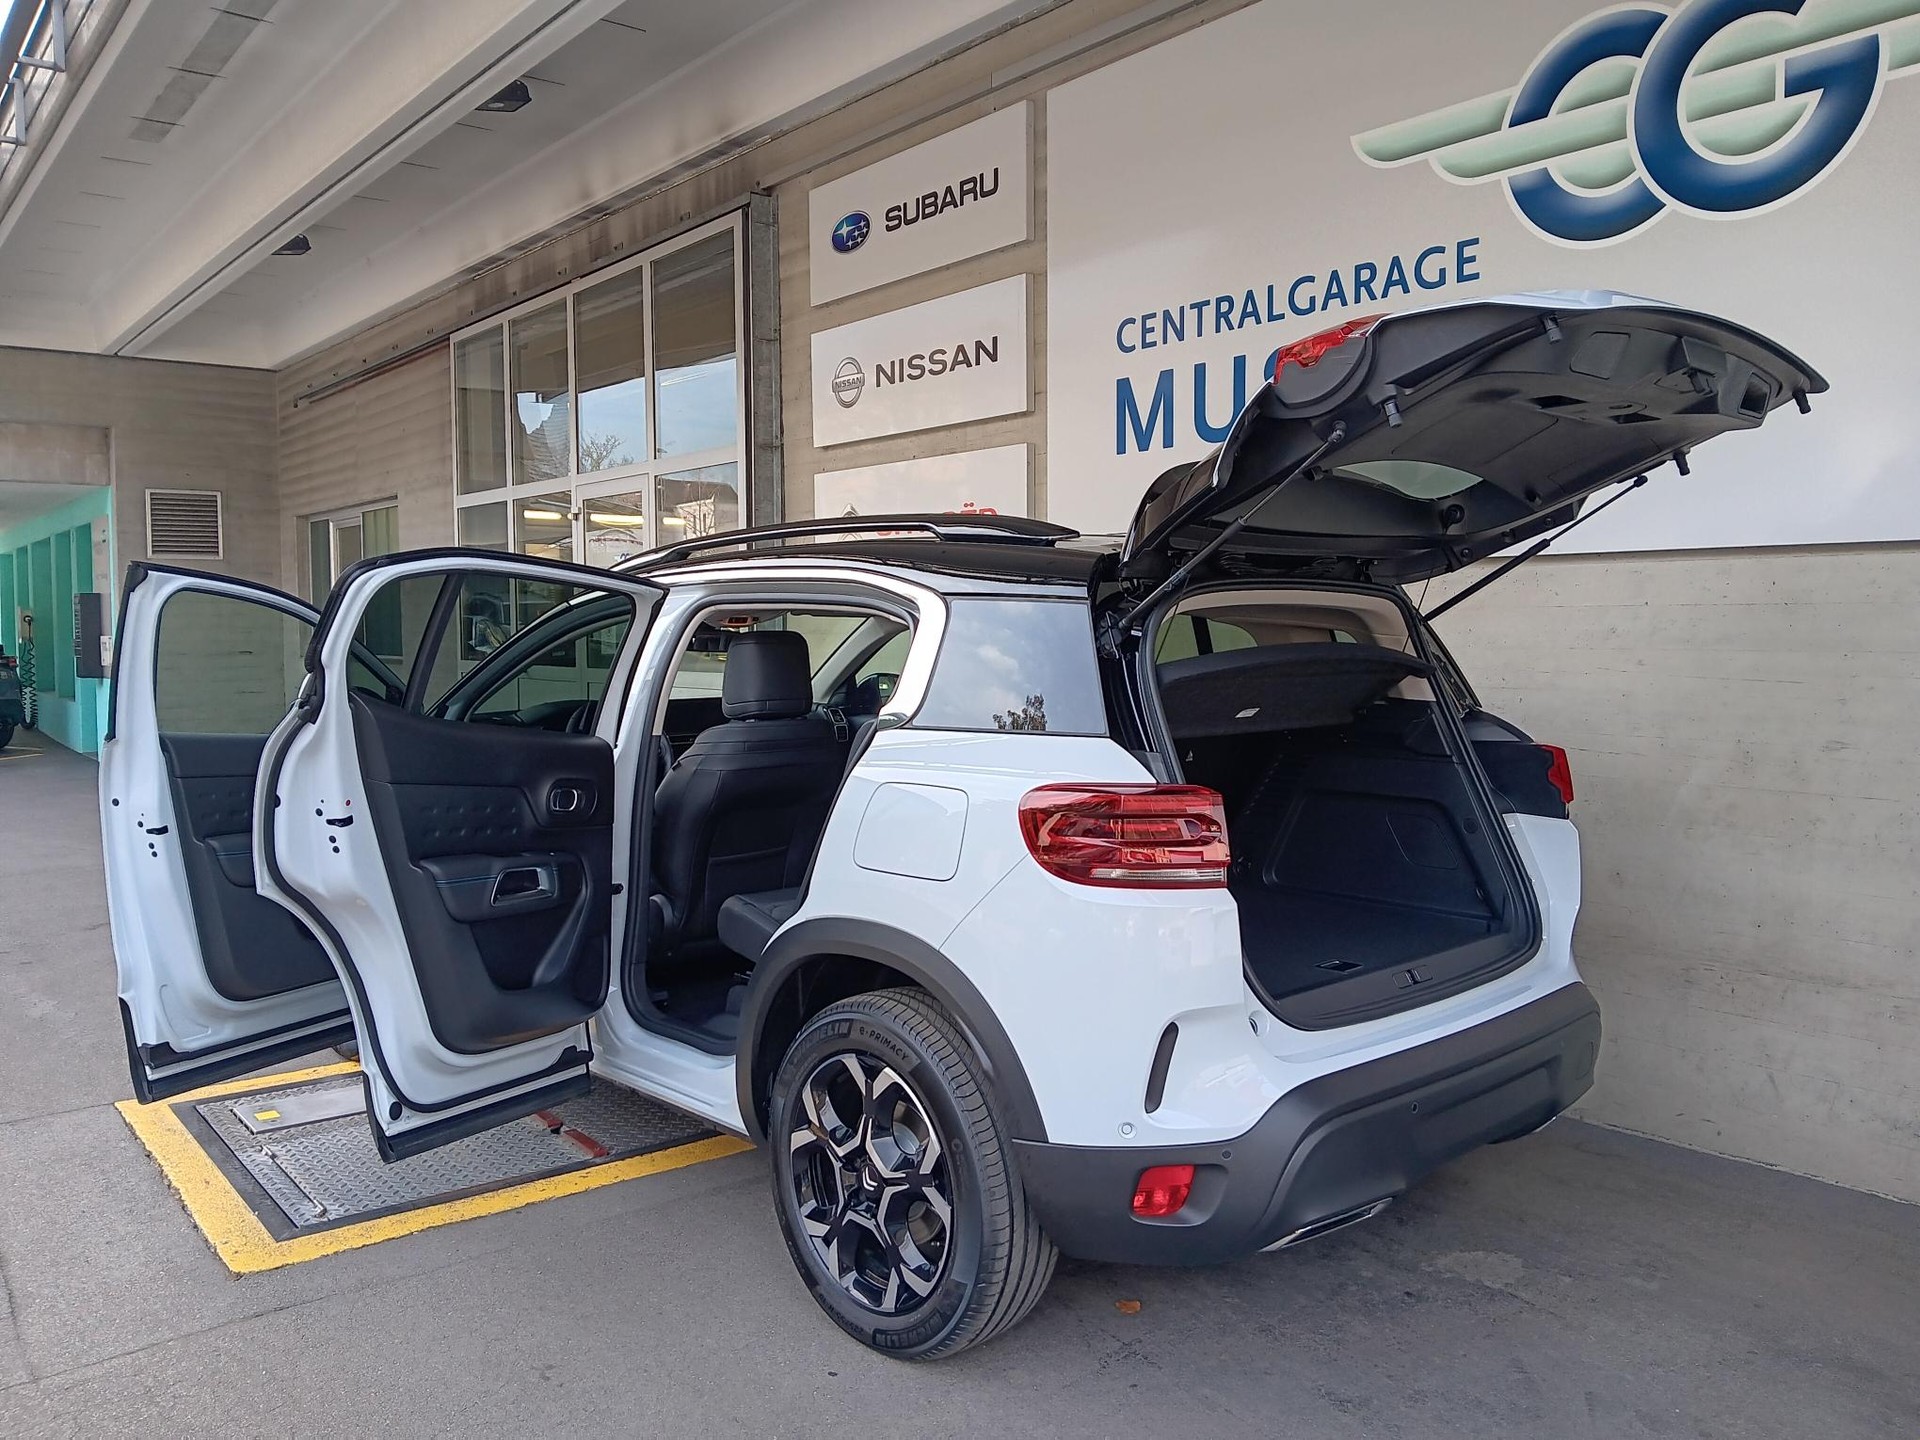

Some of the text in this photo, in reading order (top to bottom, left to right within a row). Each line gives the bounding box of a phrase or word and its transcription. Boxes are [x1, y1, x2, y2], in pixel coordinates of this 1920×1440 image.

[884, 167, 1000, 233] SUBARU
[1116, 237, 1481, 353] CENTRALGARAGE
[835, 376, 862, 389] NISSAN
[875, 336, 999, 388] NISSAN
[1115, 346, 1280, 455] MU
